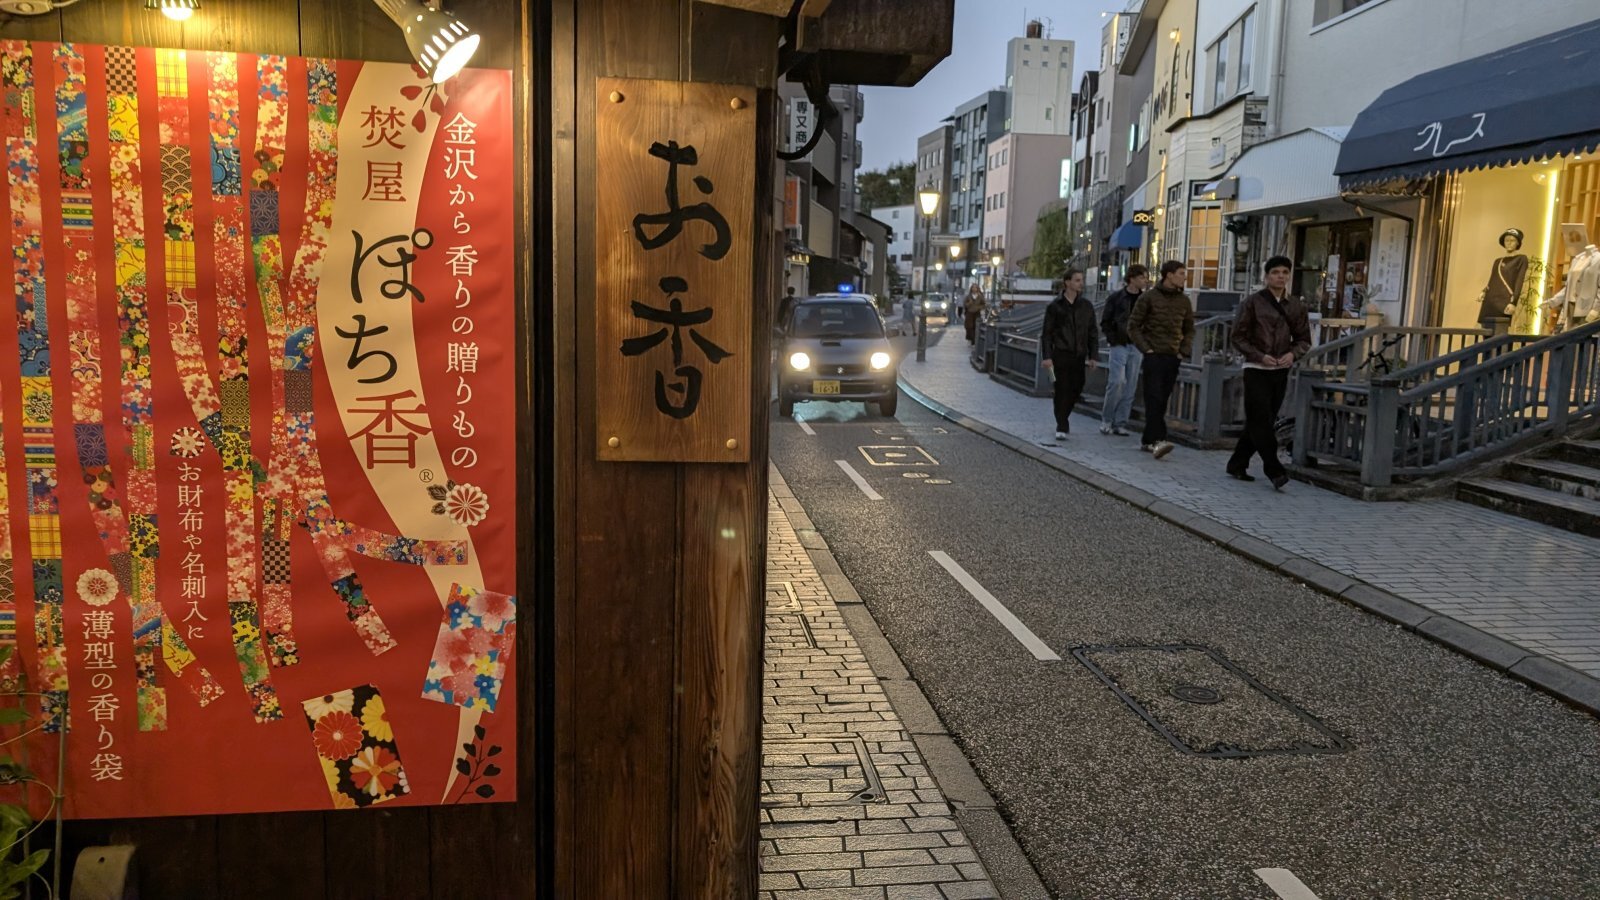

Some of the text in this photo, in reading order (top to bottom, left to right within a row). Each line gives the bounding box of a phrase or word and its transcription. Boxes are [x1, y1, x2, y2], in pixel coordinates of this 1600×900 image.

[360, 105, 407, 202] 焚屋
[334, 228, 434, 469] ぽち香
[443, 112, 479, 468] 金沢から香りの贈りもの
[619, 140, 735, 419] お香
[177, 462, 207, 640] お財布や名刺入に
[81, 610, 124, 782] 薄型の香り袋
